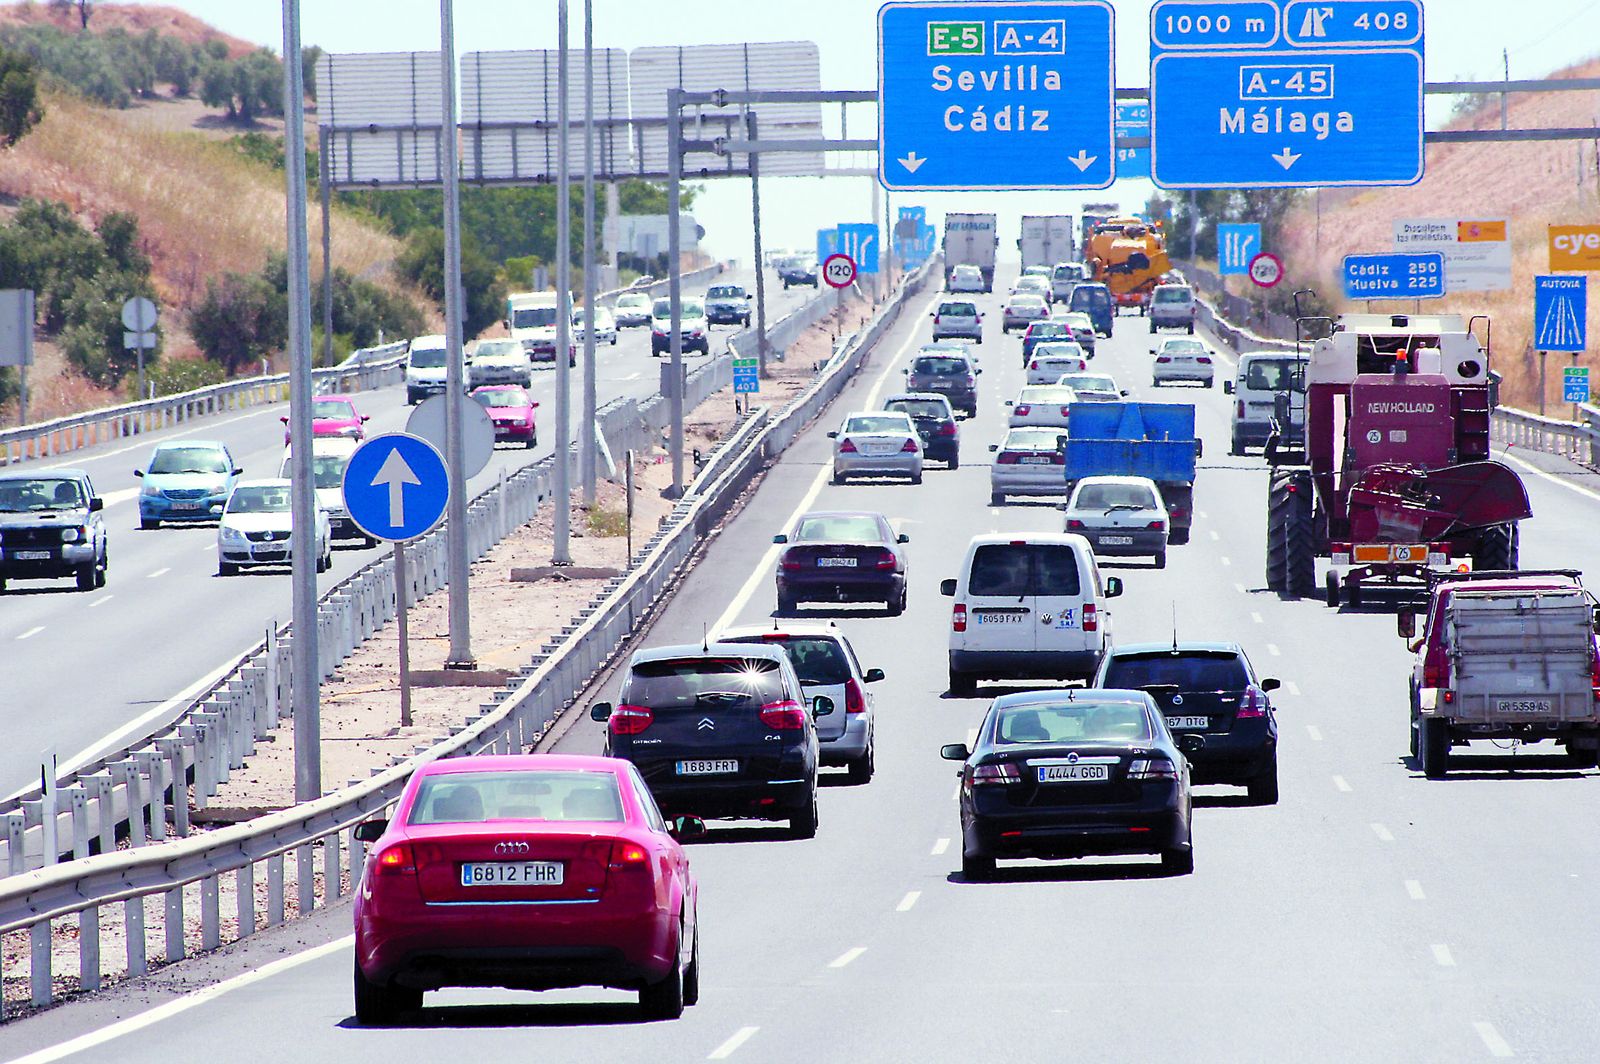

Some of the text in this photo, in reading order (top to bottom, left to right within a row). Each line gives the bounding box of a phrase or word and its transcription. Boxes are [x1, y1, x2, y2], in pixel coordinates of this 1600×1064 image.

[1165, 15, 1265, 33] 1000 m
[1353, 12, 1408, 30] 408
[933, 27, 1059, 49] E-5 A-4
[931, 64, 1061, 92] Sevilla
[1247, 71, 1327, 93] A-45
[944, 105, 1049, 131] Cádiz
[1219, 107, 1354, 140] Málaga
[829, 265, 851, 276] 120
[1349, 262, 1437, 275] Cádiz 250
[1350, 276, 1437, 290] Huelva 225
[736, 382, 755, 391] 407
[1566, 392, 1586, 401] 407
[1368, 402, 1435, 413] NEW HOLLAND
[1399, 547, 1408, 559] 25
[983, 615, 1023, 623] 6059 FXX
[1166, 717, 1205, 727] 67 DTG
[684, 761, 736, 772] 1683 FRT
[1048, 767, 1104, 779] 4444 GGD
[474, 866, 556, 881] 6812 FHR
